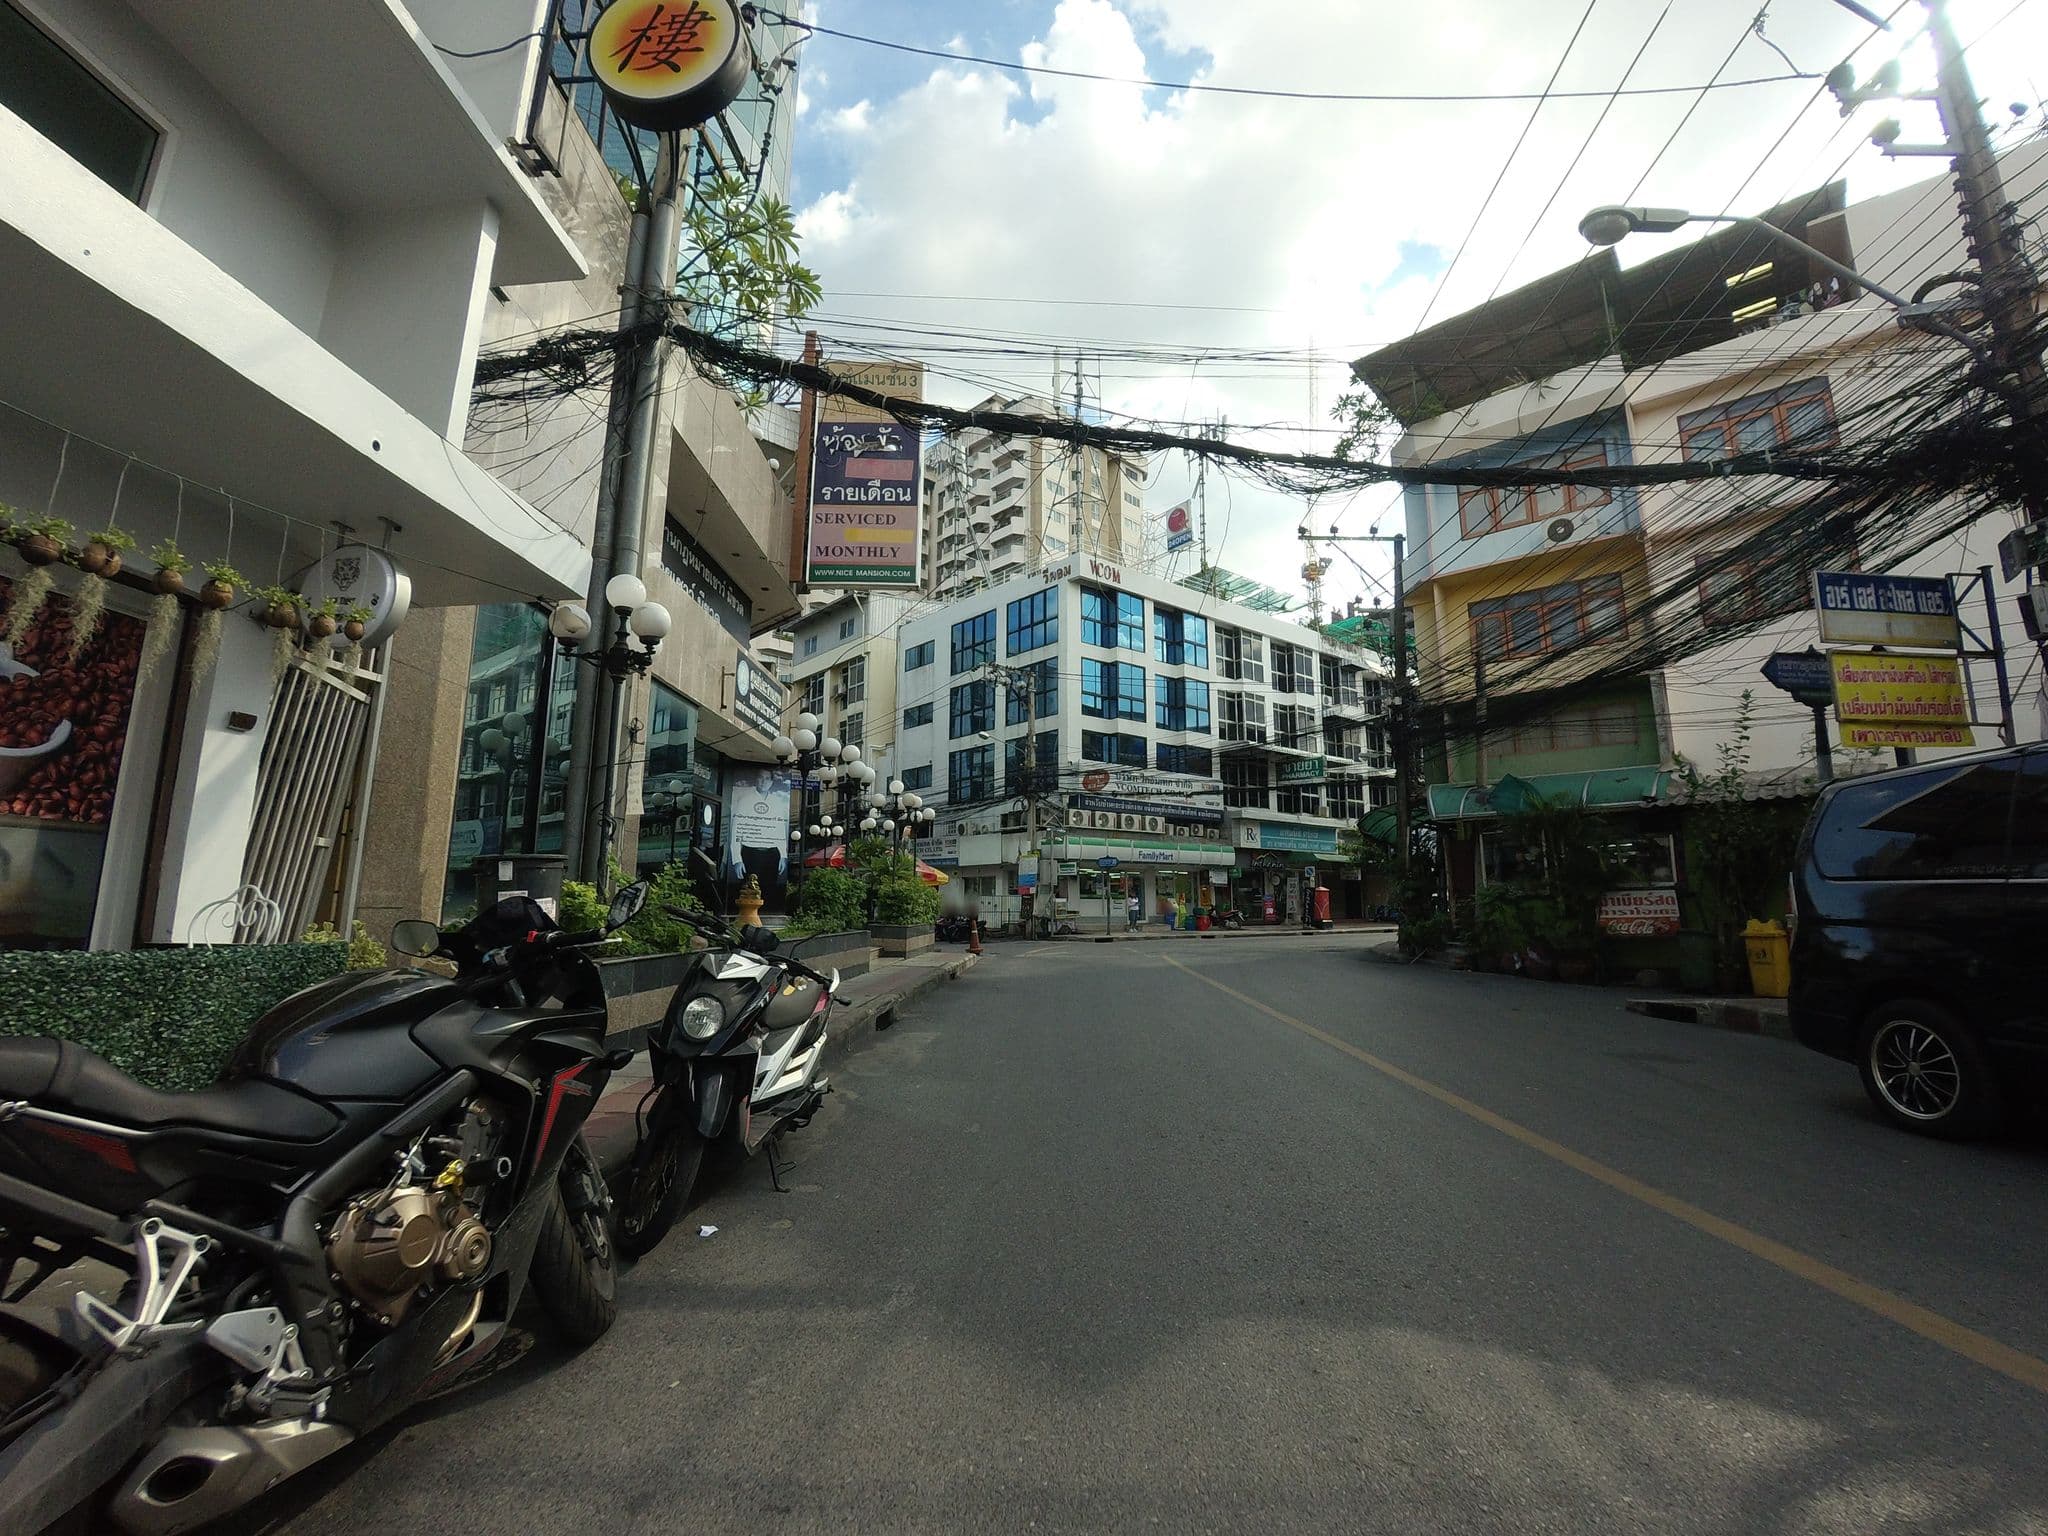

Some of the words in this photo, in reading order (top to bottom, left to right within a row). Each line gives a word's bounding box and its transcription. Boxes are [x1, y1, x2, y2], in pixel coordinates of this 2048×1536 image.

[609, 1, 717, 73] 樓
[821, 480, 912, 502] รายเดือน
[815, 512, 897, 526] SERVICED
[815, 545, 901, 559] MONTHLY
[1825, 580, 1851, 608] อาร์
[1852, 583, 1877, 610] เอส
[1917, 587, 1945, 614] แอร์
[1138, 850, 1174, 861] FamilyMart
